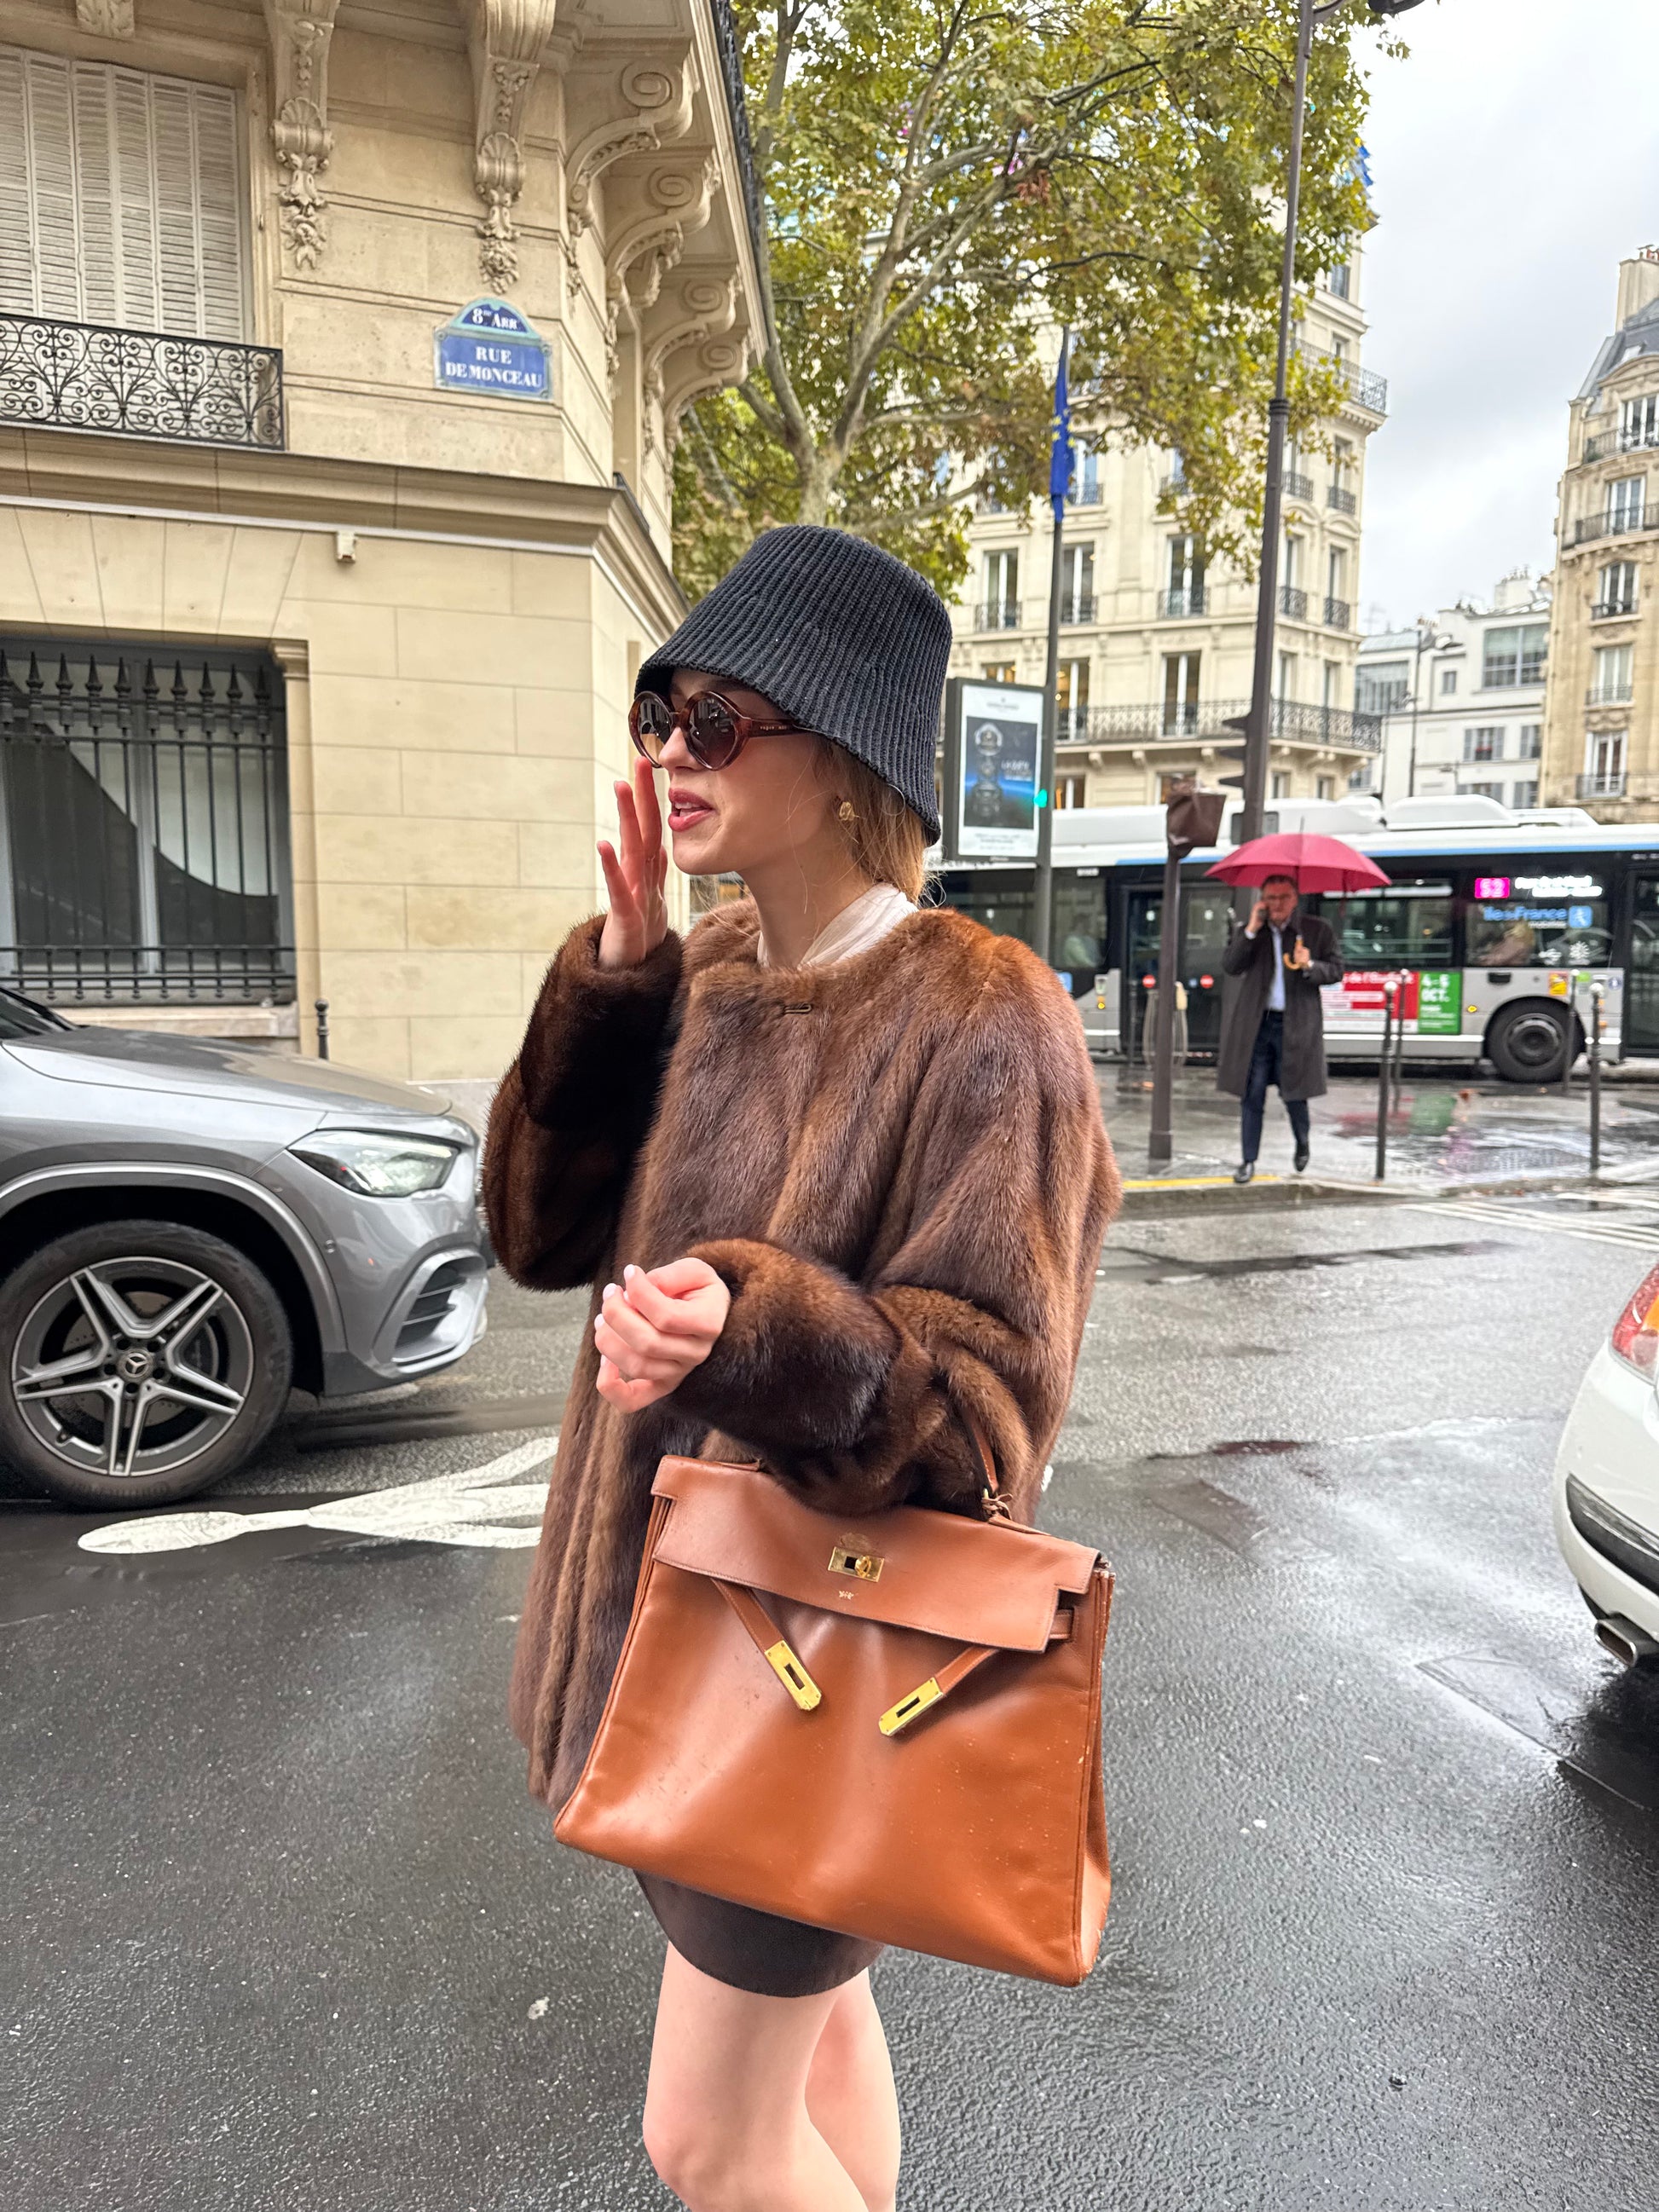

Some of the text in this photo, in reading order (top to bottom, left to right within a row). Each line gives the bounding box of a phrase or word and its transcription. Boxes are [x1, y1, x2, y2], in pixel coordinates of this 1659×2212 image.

[475, 346, 512, 365] RUE
[445, 361, 542, 388] DE MONCEAU
